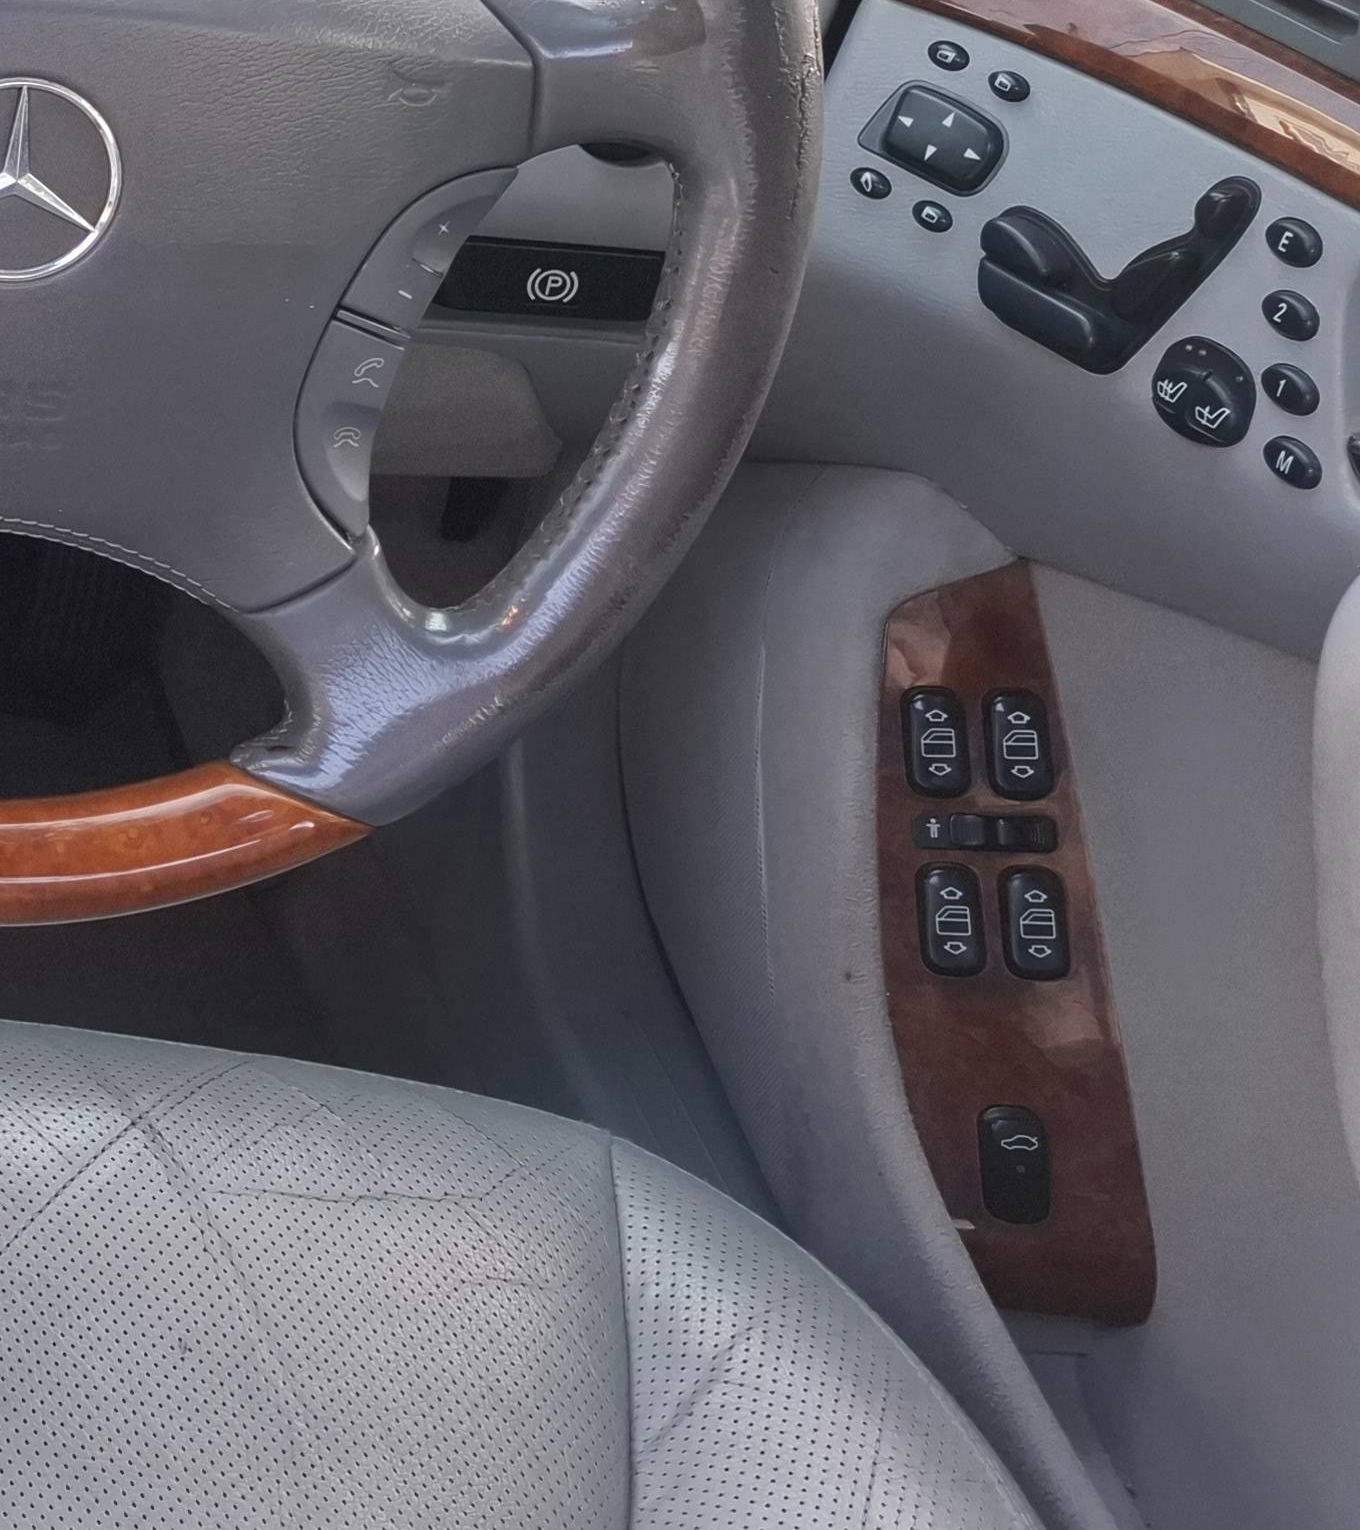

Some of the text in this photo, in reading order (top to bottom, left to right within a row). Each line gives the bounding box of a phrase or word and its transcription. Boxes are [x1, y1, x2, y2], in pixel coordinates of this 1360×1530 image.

[1277, 230, 1294, 252] E
[1272, 303, 1288, 323] 2
[1276, 379, 1287, 398] 1
[1275, 450, 1295, 475] M
